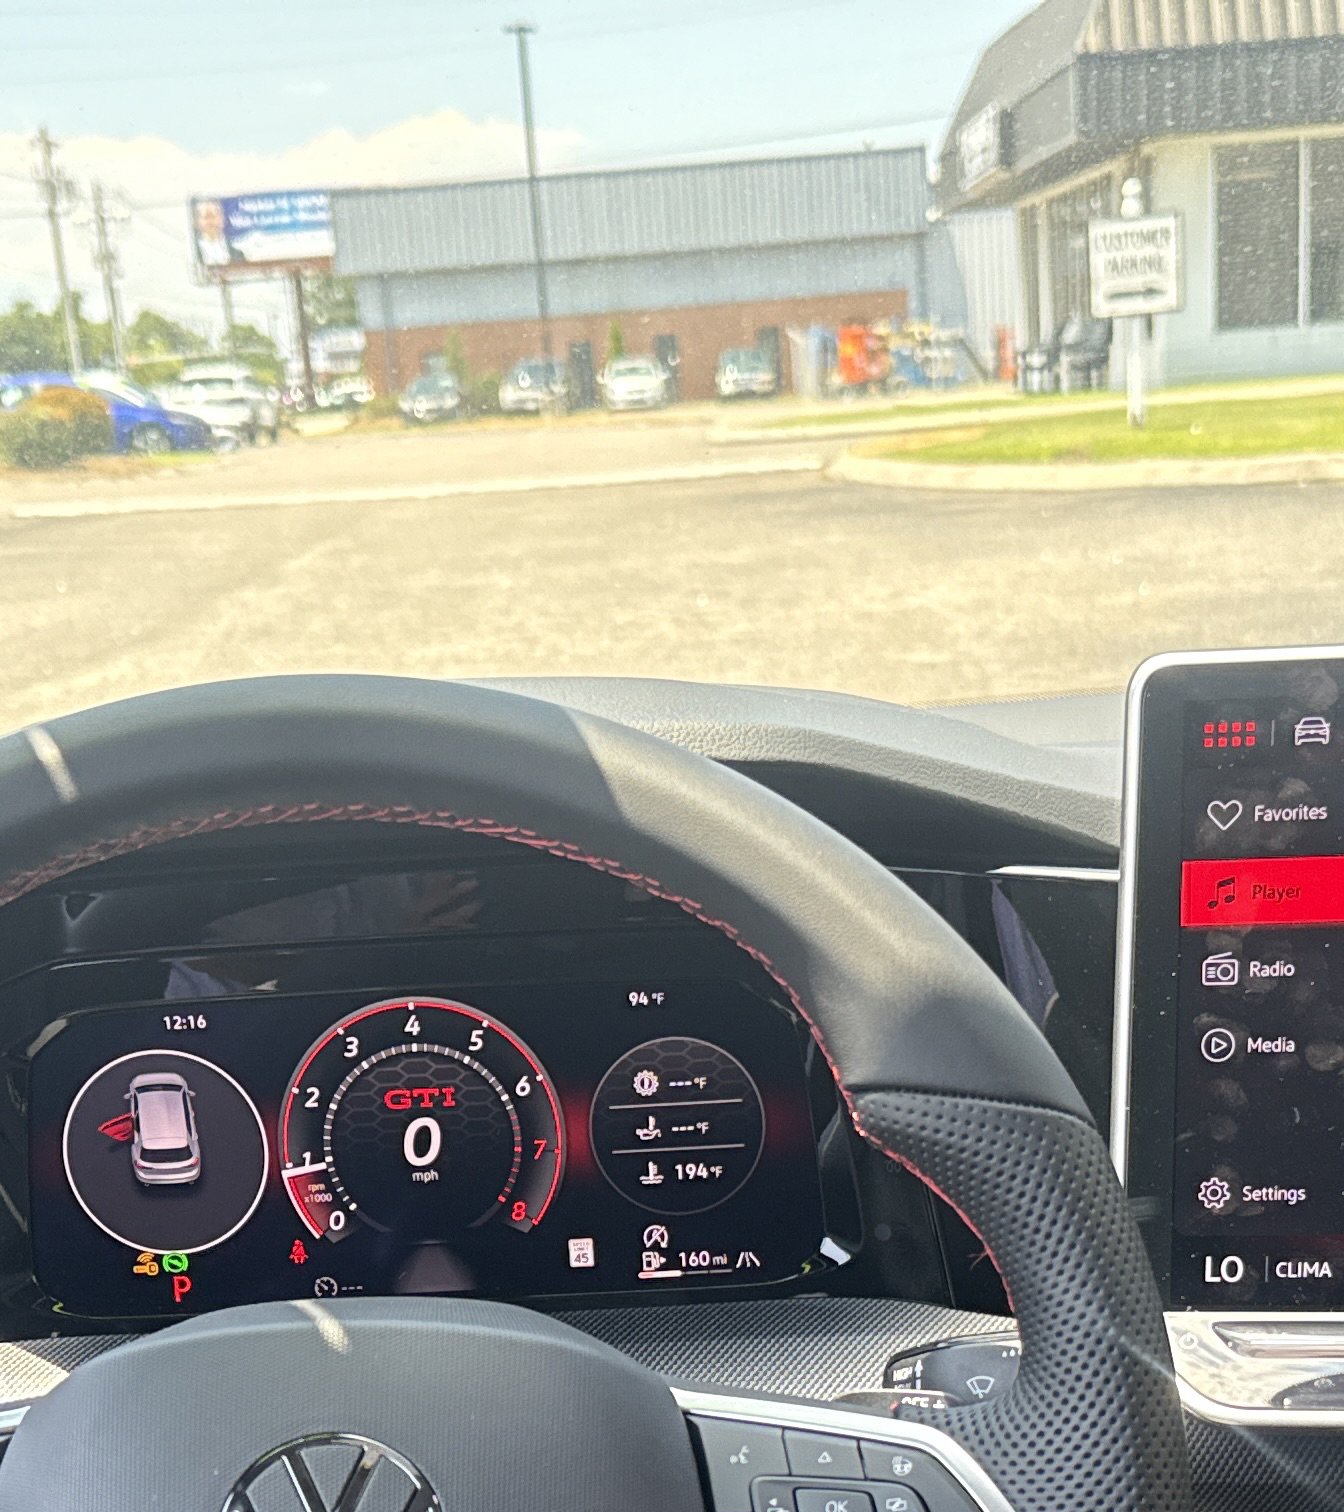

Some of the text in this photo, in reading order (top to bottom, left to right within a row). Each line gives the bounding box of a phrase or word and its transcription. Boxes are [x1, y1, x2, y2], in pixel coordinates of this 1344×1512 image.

[1095, 227, 1171, 253] CUSTOMER
[1106, 253, 1168, 276] PARKING
[1254, 804, 1328, 822] Favorites
[1252, 884, 1301, 903] Player
[1249, 961, 1295, 978] Radio
[628, 991, 649, 1007] 94
[163, 1014, 207, 1031] 12:16
[404, 1014, 421, 1036] 4
[344, 1037, 359, 1058] 3
[469, 1030, 484, 1052] 5
[1247, 1036, 1296, 1054] Media
[515, 1075, 531, 1097] 6
[305, 1087, 320, 1108] 2
[384, 1086, 456, 1110] GTI
[403, 1116, 441, 1167] 0
[533, 1138, 548, 1160] 7
[301, 1151, 312, 1167] 1
[412, 1169, 439, 1184] mph
[304, 1192, 333, 1203] x1000
[307, 1183, 326, 1193] rpm
[1241, 1184, 1307, 1206] Settings
[329, 1210, 345, 1231] 0
[511, 1200, 527, 1222] 8
[574, 1253, 589, 1264] 45
[678, 1250, 710, 1267] 160
[1205, 1255, 1244, 1284] LO
[1275, 1261, 1332, 1279] CLIMA
[173, 1276, 192, 1302] P
